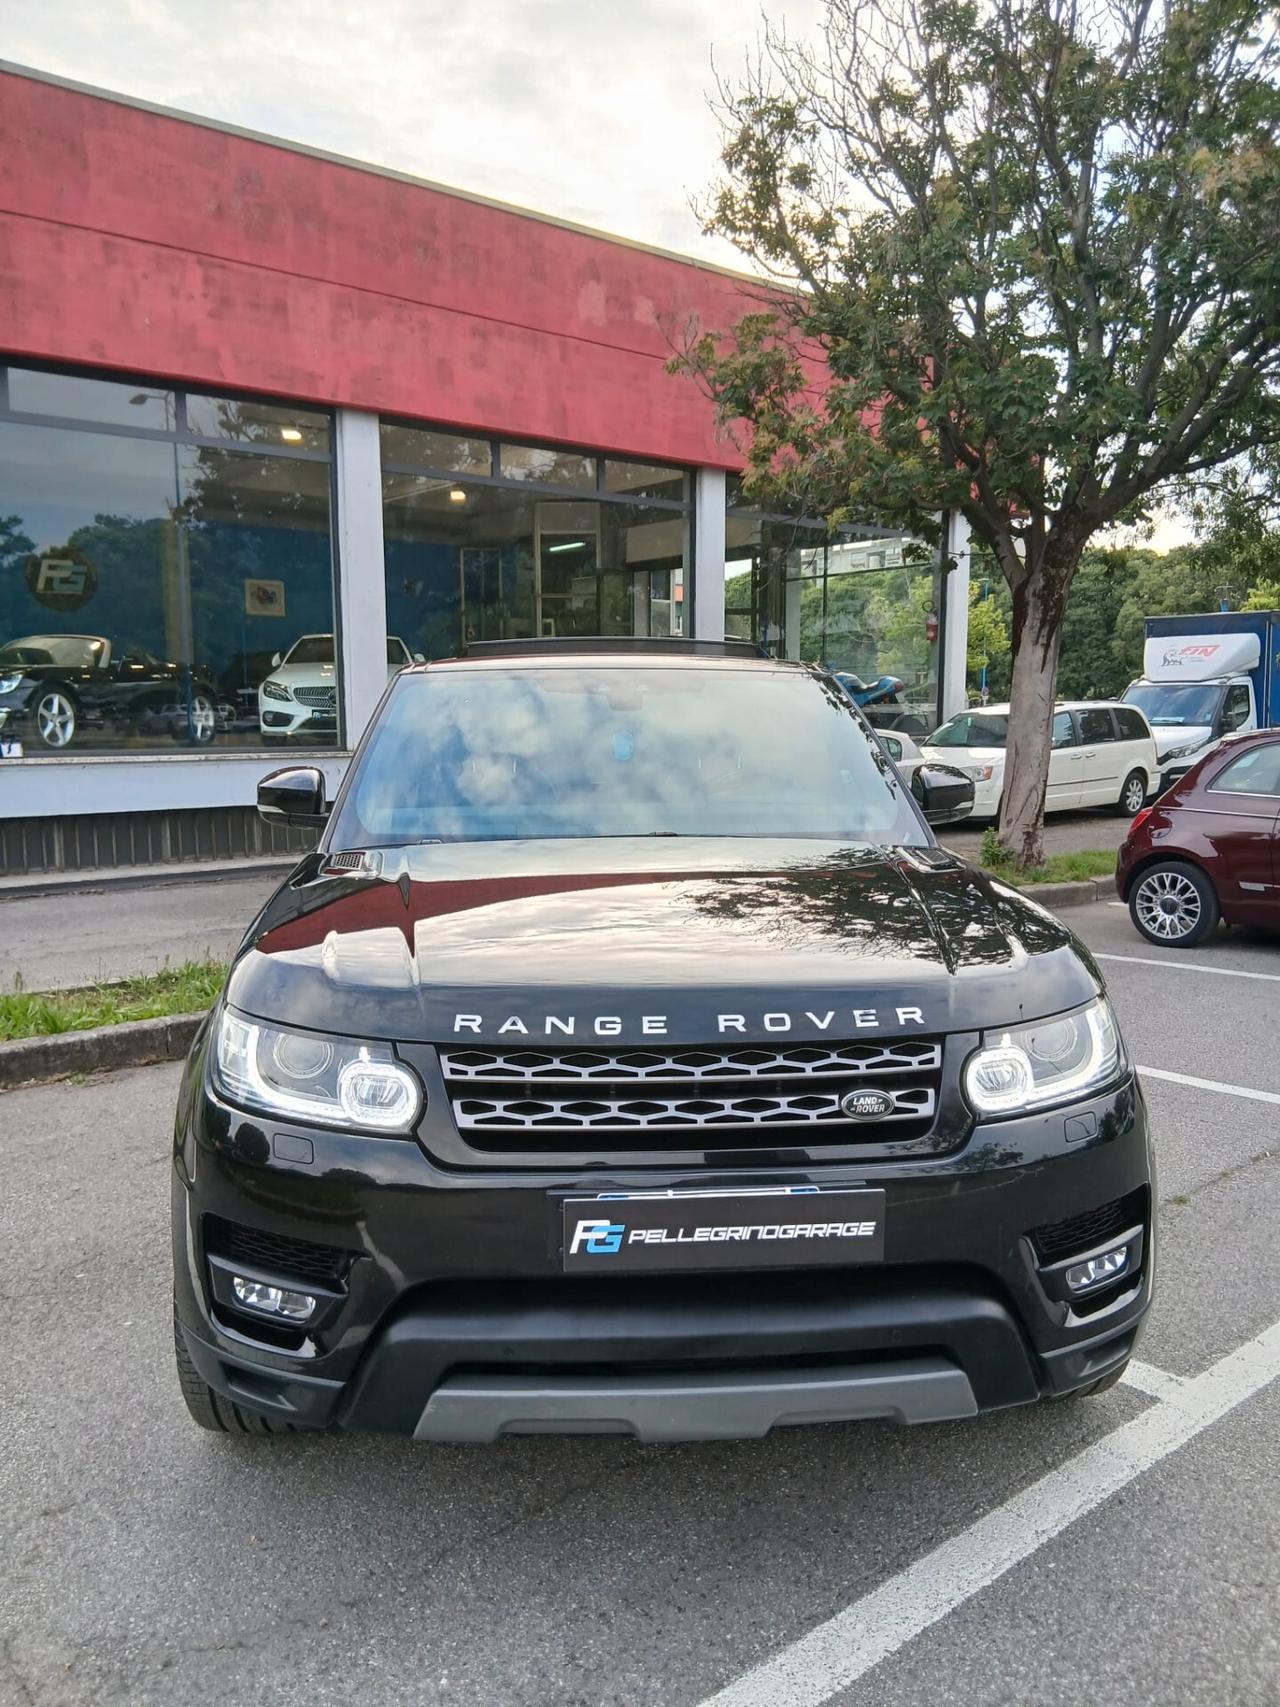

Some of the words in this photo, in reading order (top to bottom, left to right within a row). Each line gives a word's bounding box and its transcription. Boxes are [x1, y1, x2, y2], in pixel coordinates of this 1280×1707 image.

[453, 1013, 668, 1035] RANGE
[717, 1007, 926, 1032] ROVER
[853, 1097, 878, 1105] LAND
[856, 1104, 885, 1113] ROVER
[569, 1219, 625, 1255] PG
[628, 1221, 877, 1244] PELLEGRINOGARAGE
